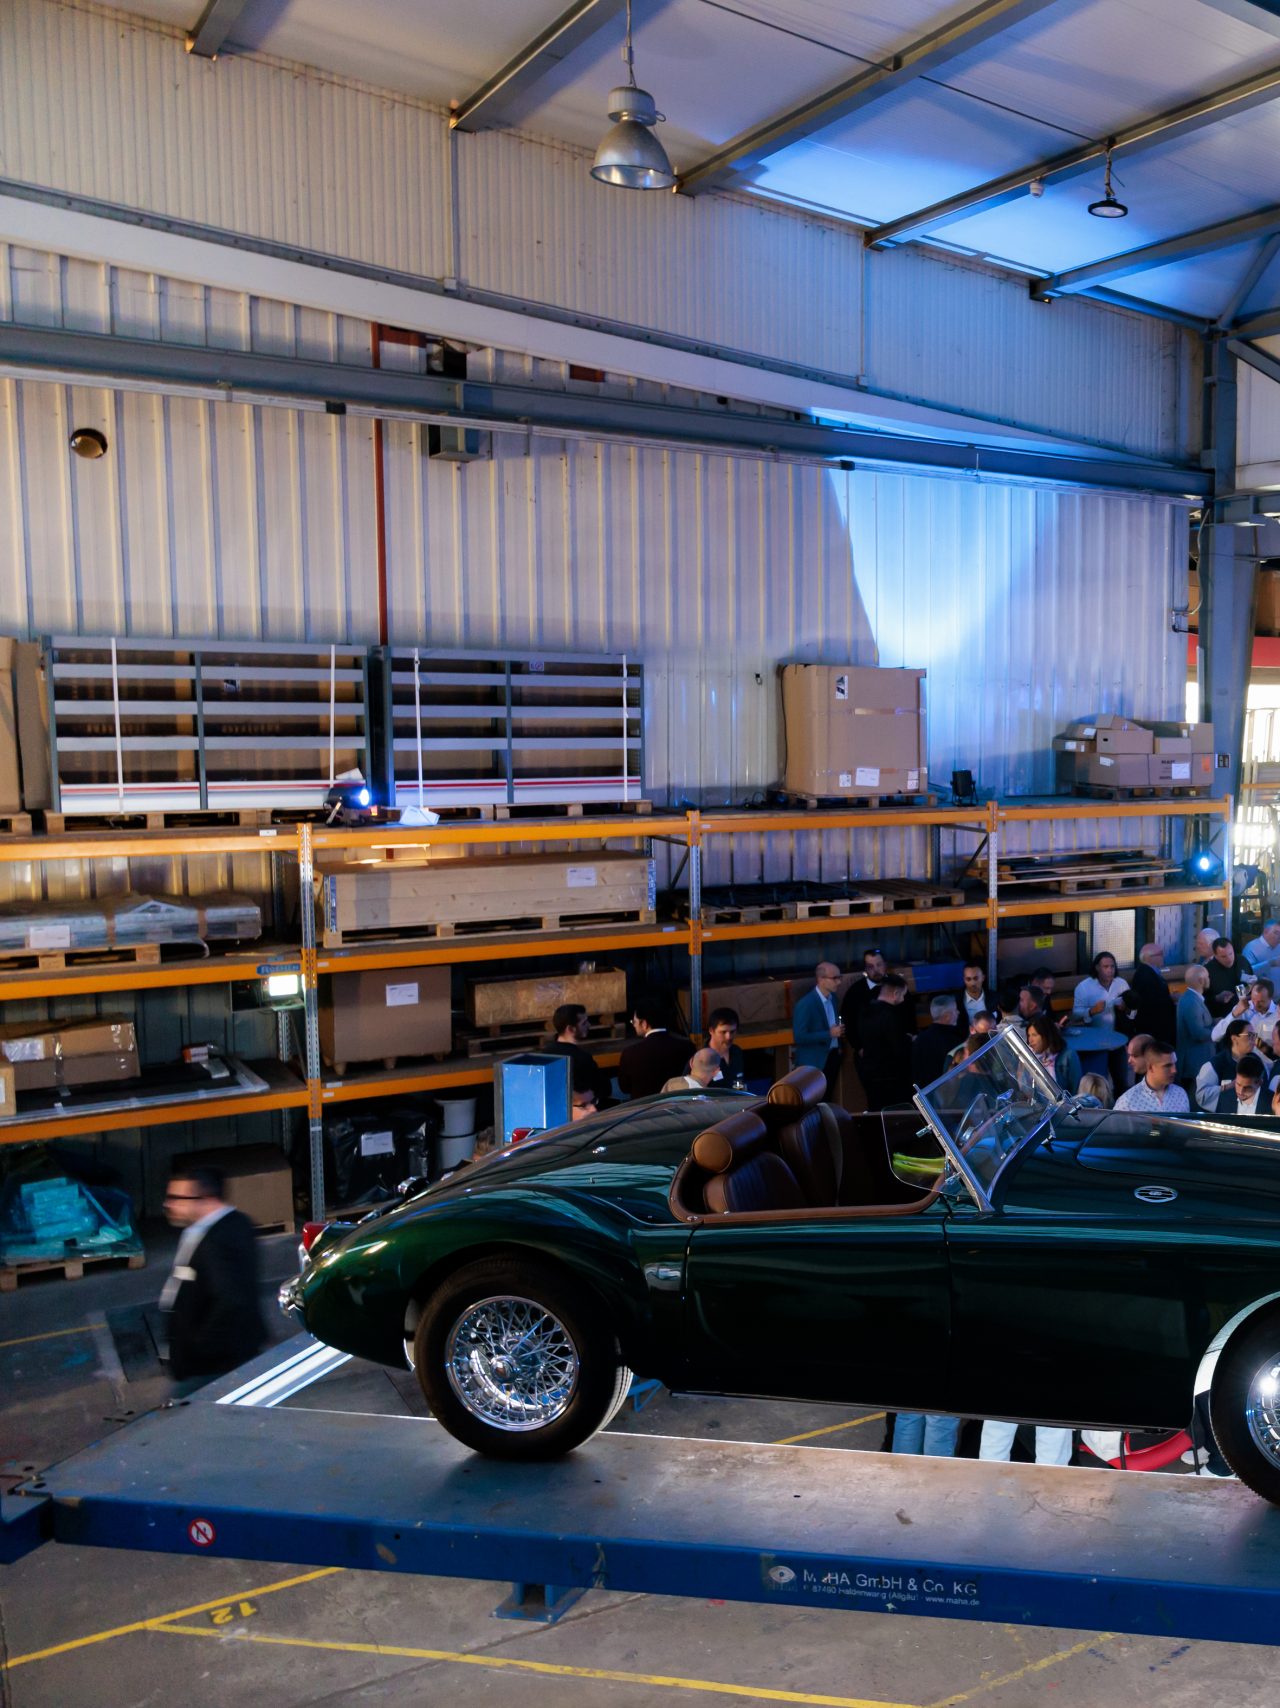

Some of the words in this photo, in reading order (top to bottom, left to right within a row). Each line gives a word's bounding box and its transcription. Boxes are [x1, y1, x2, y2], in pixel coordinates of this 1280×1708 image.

[855, 1573, 903, 1590] GmbH
[907, 1577, 918, 1591] &
[953, 1581, 977, 1597] KG
[210, 1602, 257, 1625] 12
